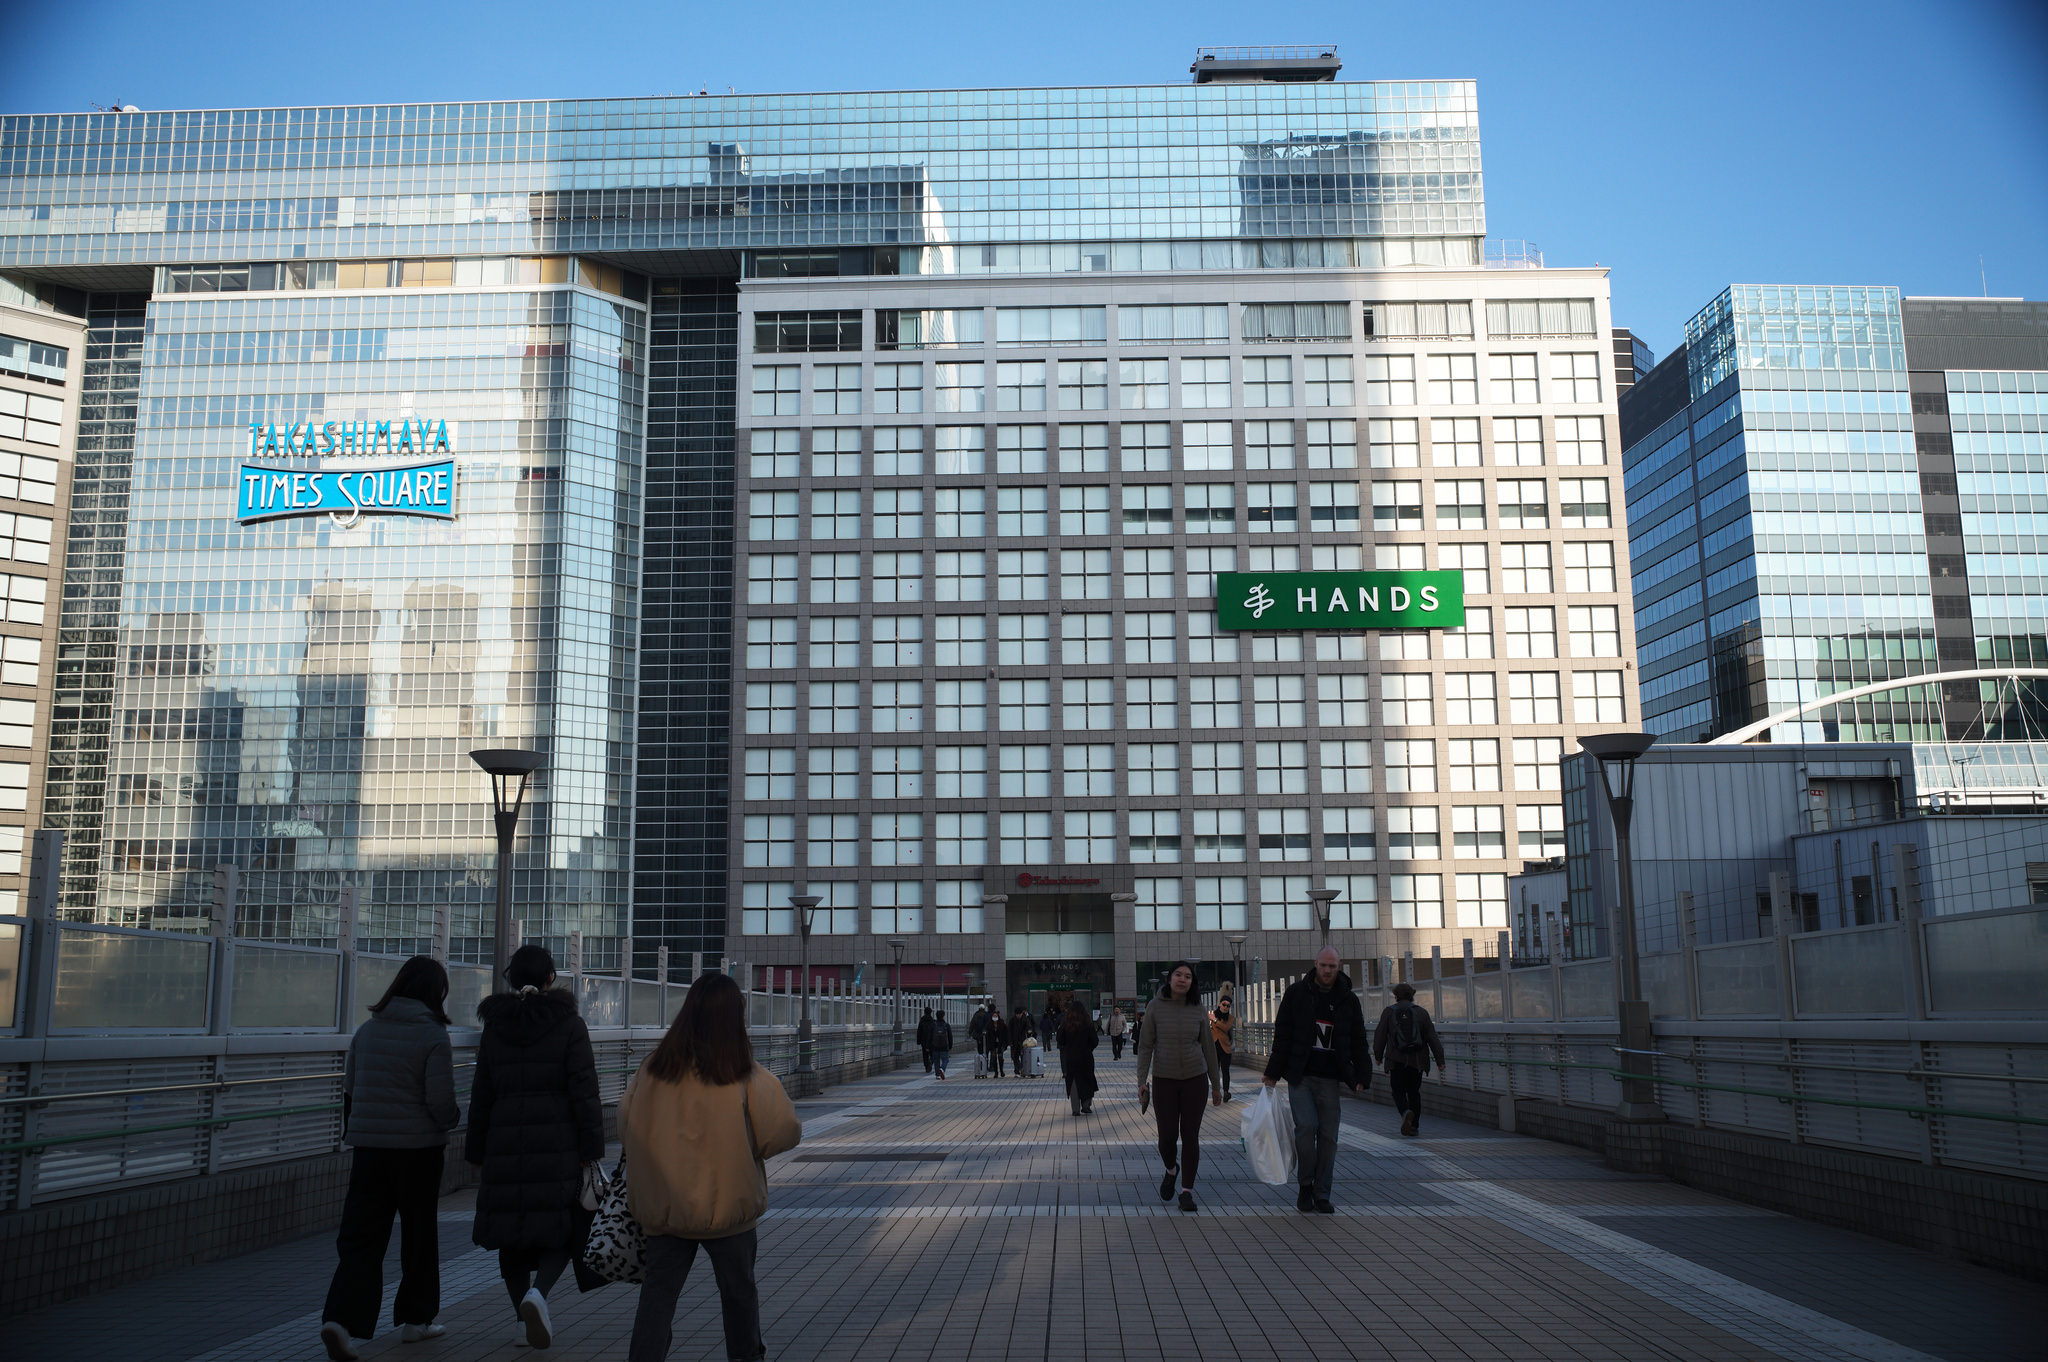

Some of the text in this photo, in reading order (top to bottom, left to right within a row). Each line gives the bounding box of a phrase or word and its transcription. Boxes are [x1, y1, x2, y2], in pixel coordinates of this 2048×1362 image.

[250, 419, 450, 454] TAKASHIMAYA
[245, 470, 448, 525] TIMES SQUARE
[1296, 586, 1439, 613] HANDS
